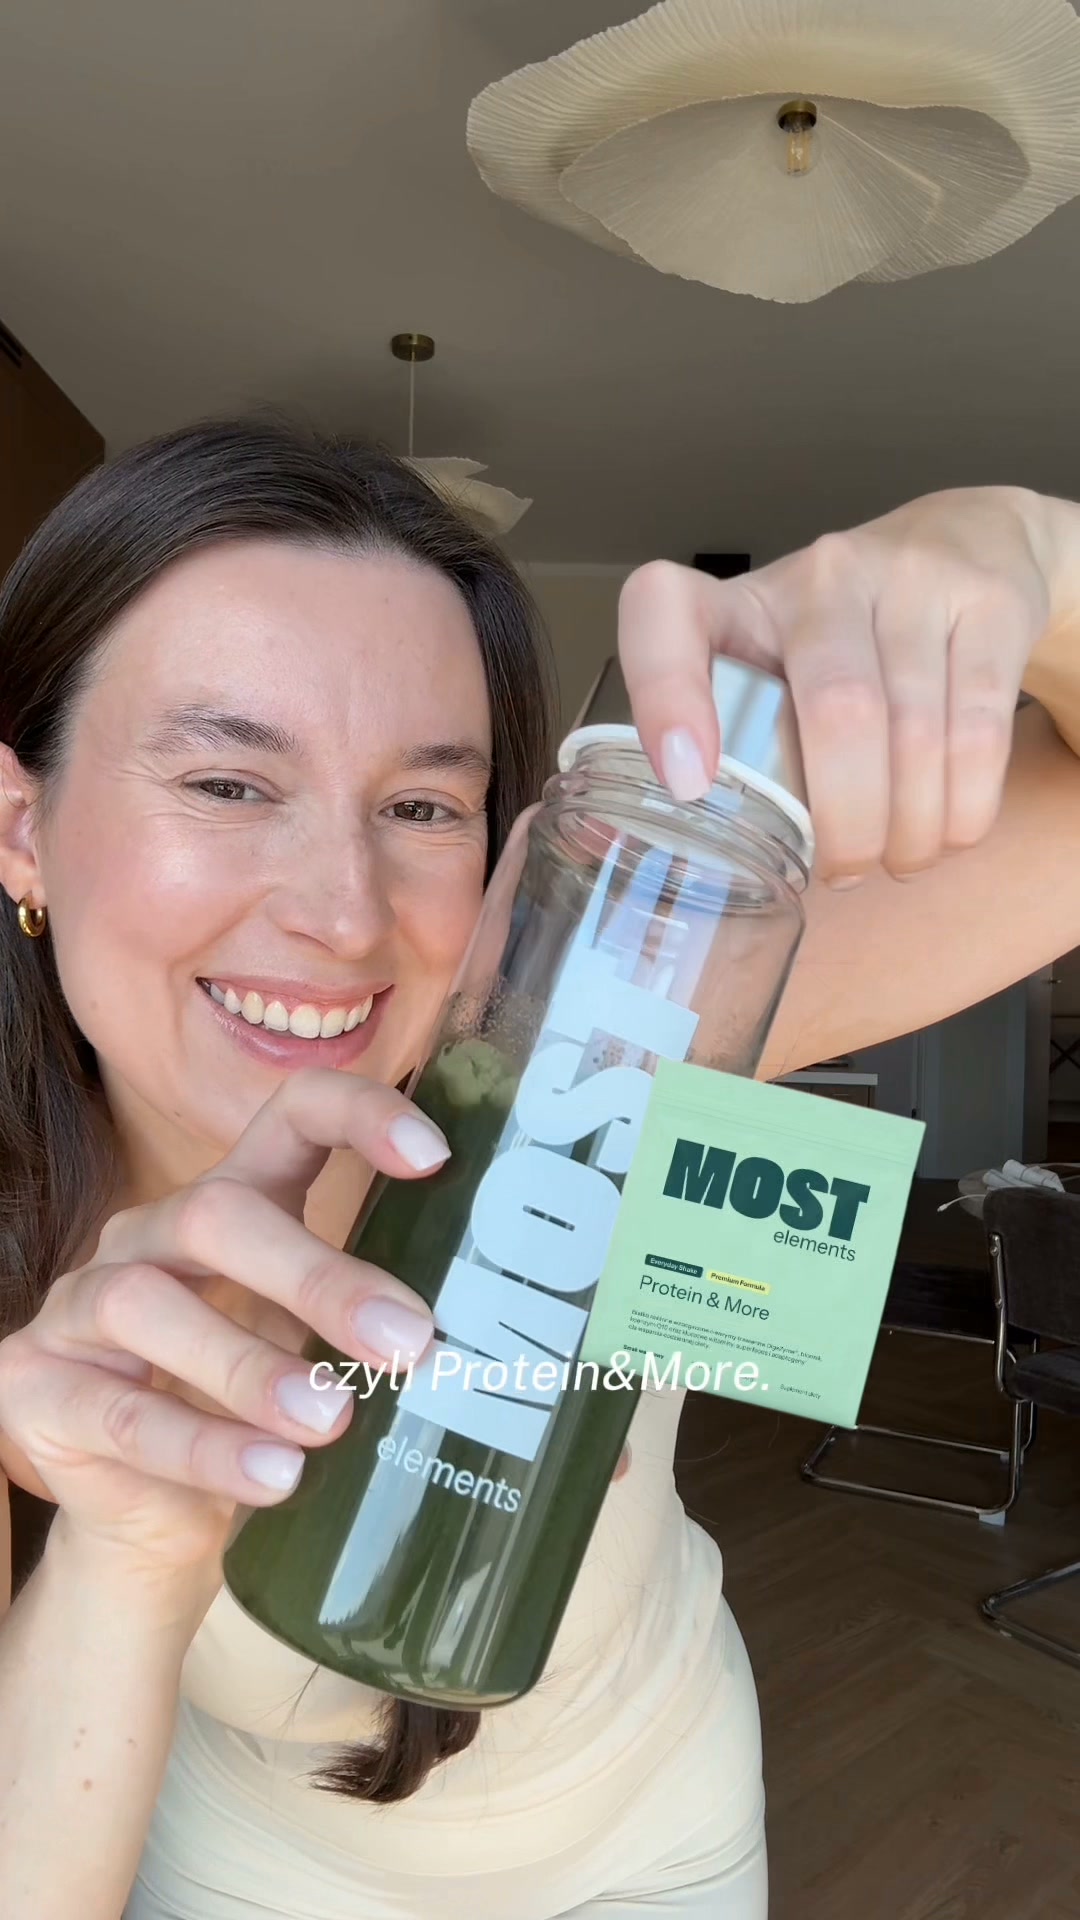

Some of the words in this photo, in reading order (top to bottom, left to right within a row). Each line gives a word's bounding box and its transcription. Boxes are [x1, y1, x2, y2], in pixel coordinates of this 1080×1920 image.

[397, 833, 699, 1462] MOST
[662, 1138, 871, 1241] MOST
[649, 1257, 679, 1270] Everyday
[678, 1264, 699, 1274] Shake
[773, 1229, 856, 1262] elements
[639, 1274, 703, 1305] Protein
[706, 1292, 720, 1309] &
[724, 1295, 770, 1321] More
[710, 1272, 739, 1284] Premium
[739, 1280, 766, 1291] Formula
[376, 1433, 522, 1513] elements
